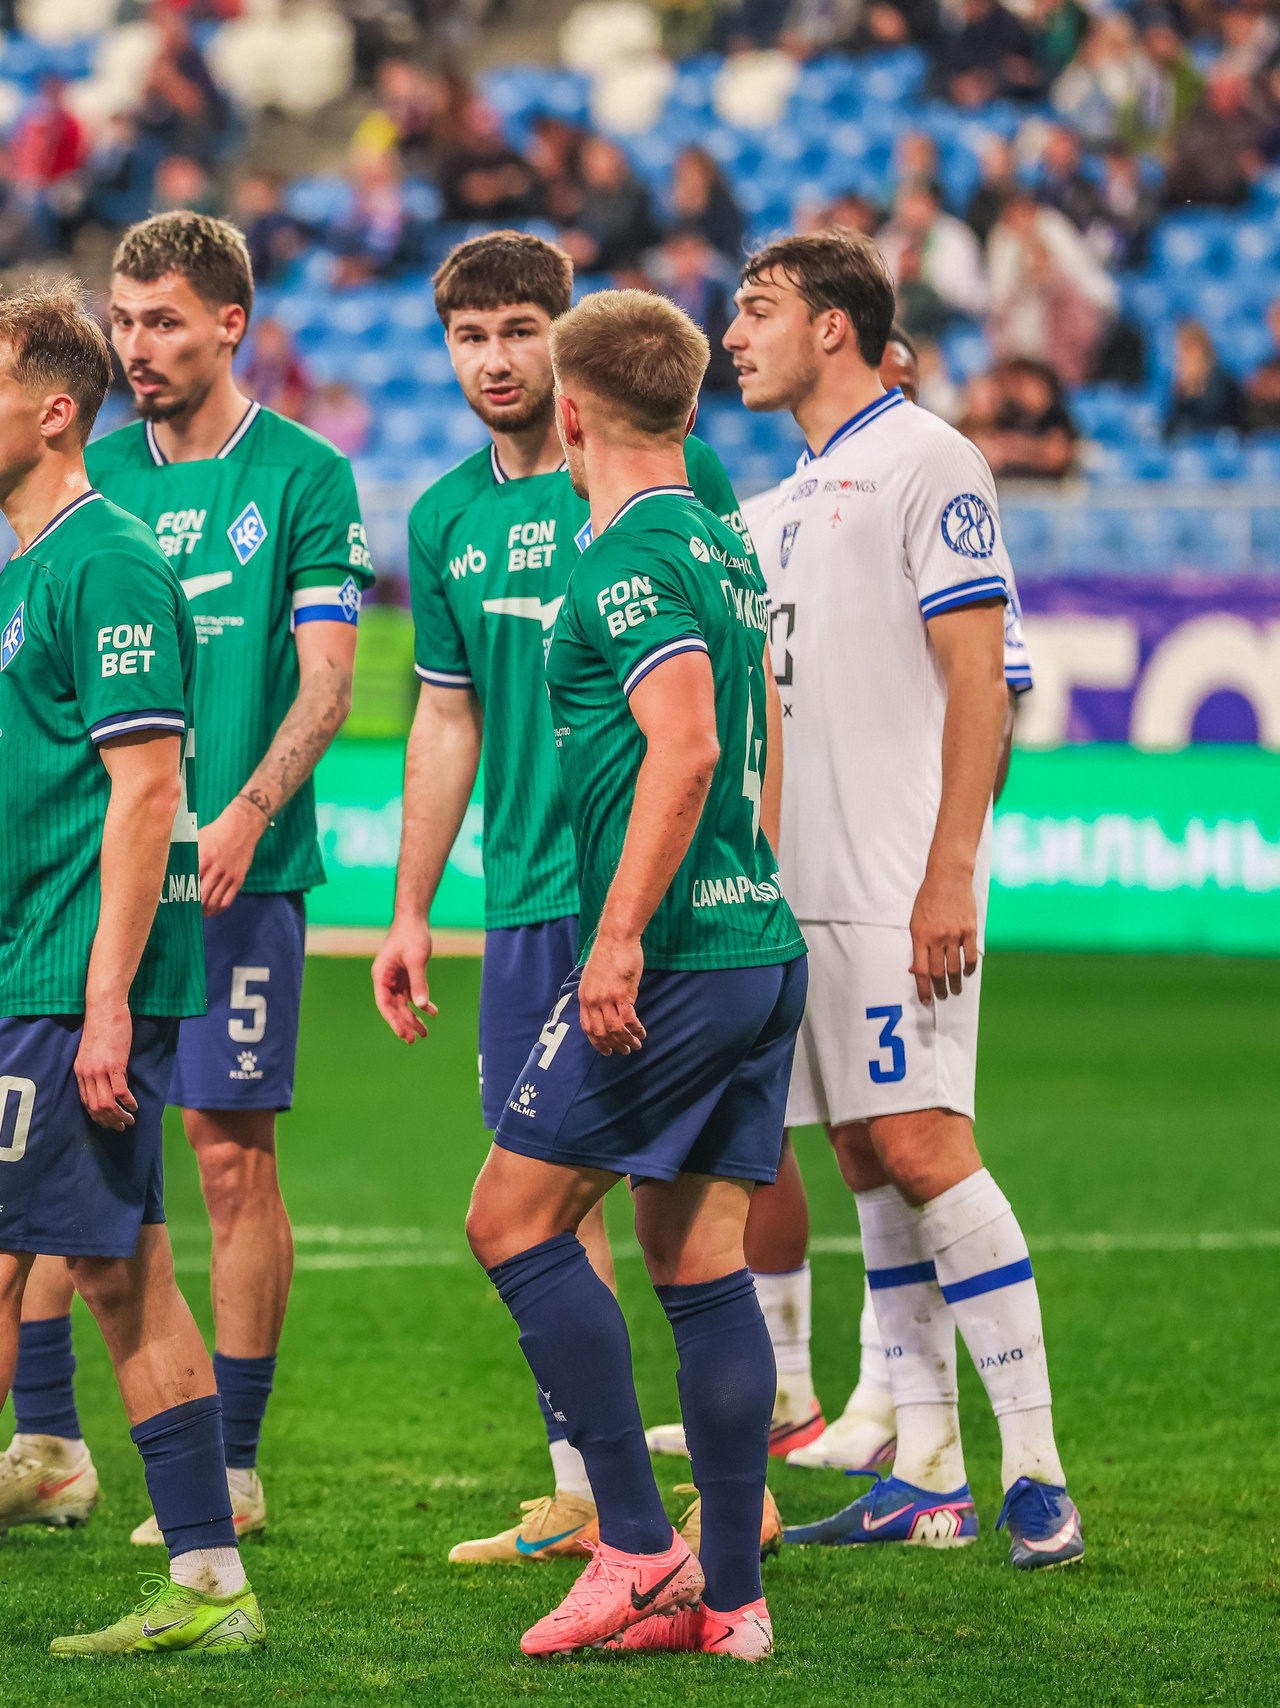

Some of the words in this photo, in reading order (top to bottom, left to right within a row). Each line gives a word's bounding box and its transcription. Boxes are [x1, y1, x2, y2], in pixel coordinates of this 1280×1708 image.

[155, 508, 207, 534] FON
[507, 519, 556, 549] FON
[449, 543, 487, 580] wb
[507, 543, 557, 572] BET
[597, 576, 653, 617] FON
[606, 595, 659, 639] BET
[97, 624, 154, 652] FON
[101, 649, 156, 678] BET
[228, 966, 270, 1043] 5
[537, 992, 573, 1071] 4
[866, 1004, 907, 1084] 3
[508, 1100, 537, 1118] KELME
[980, 1348, 1024, 1369] JAKO
